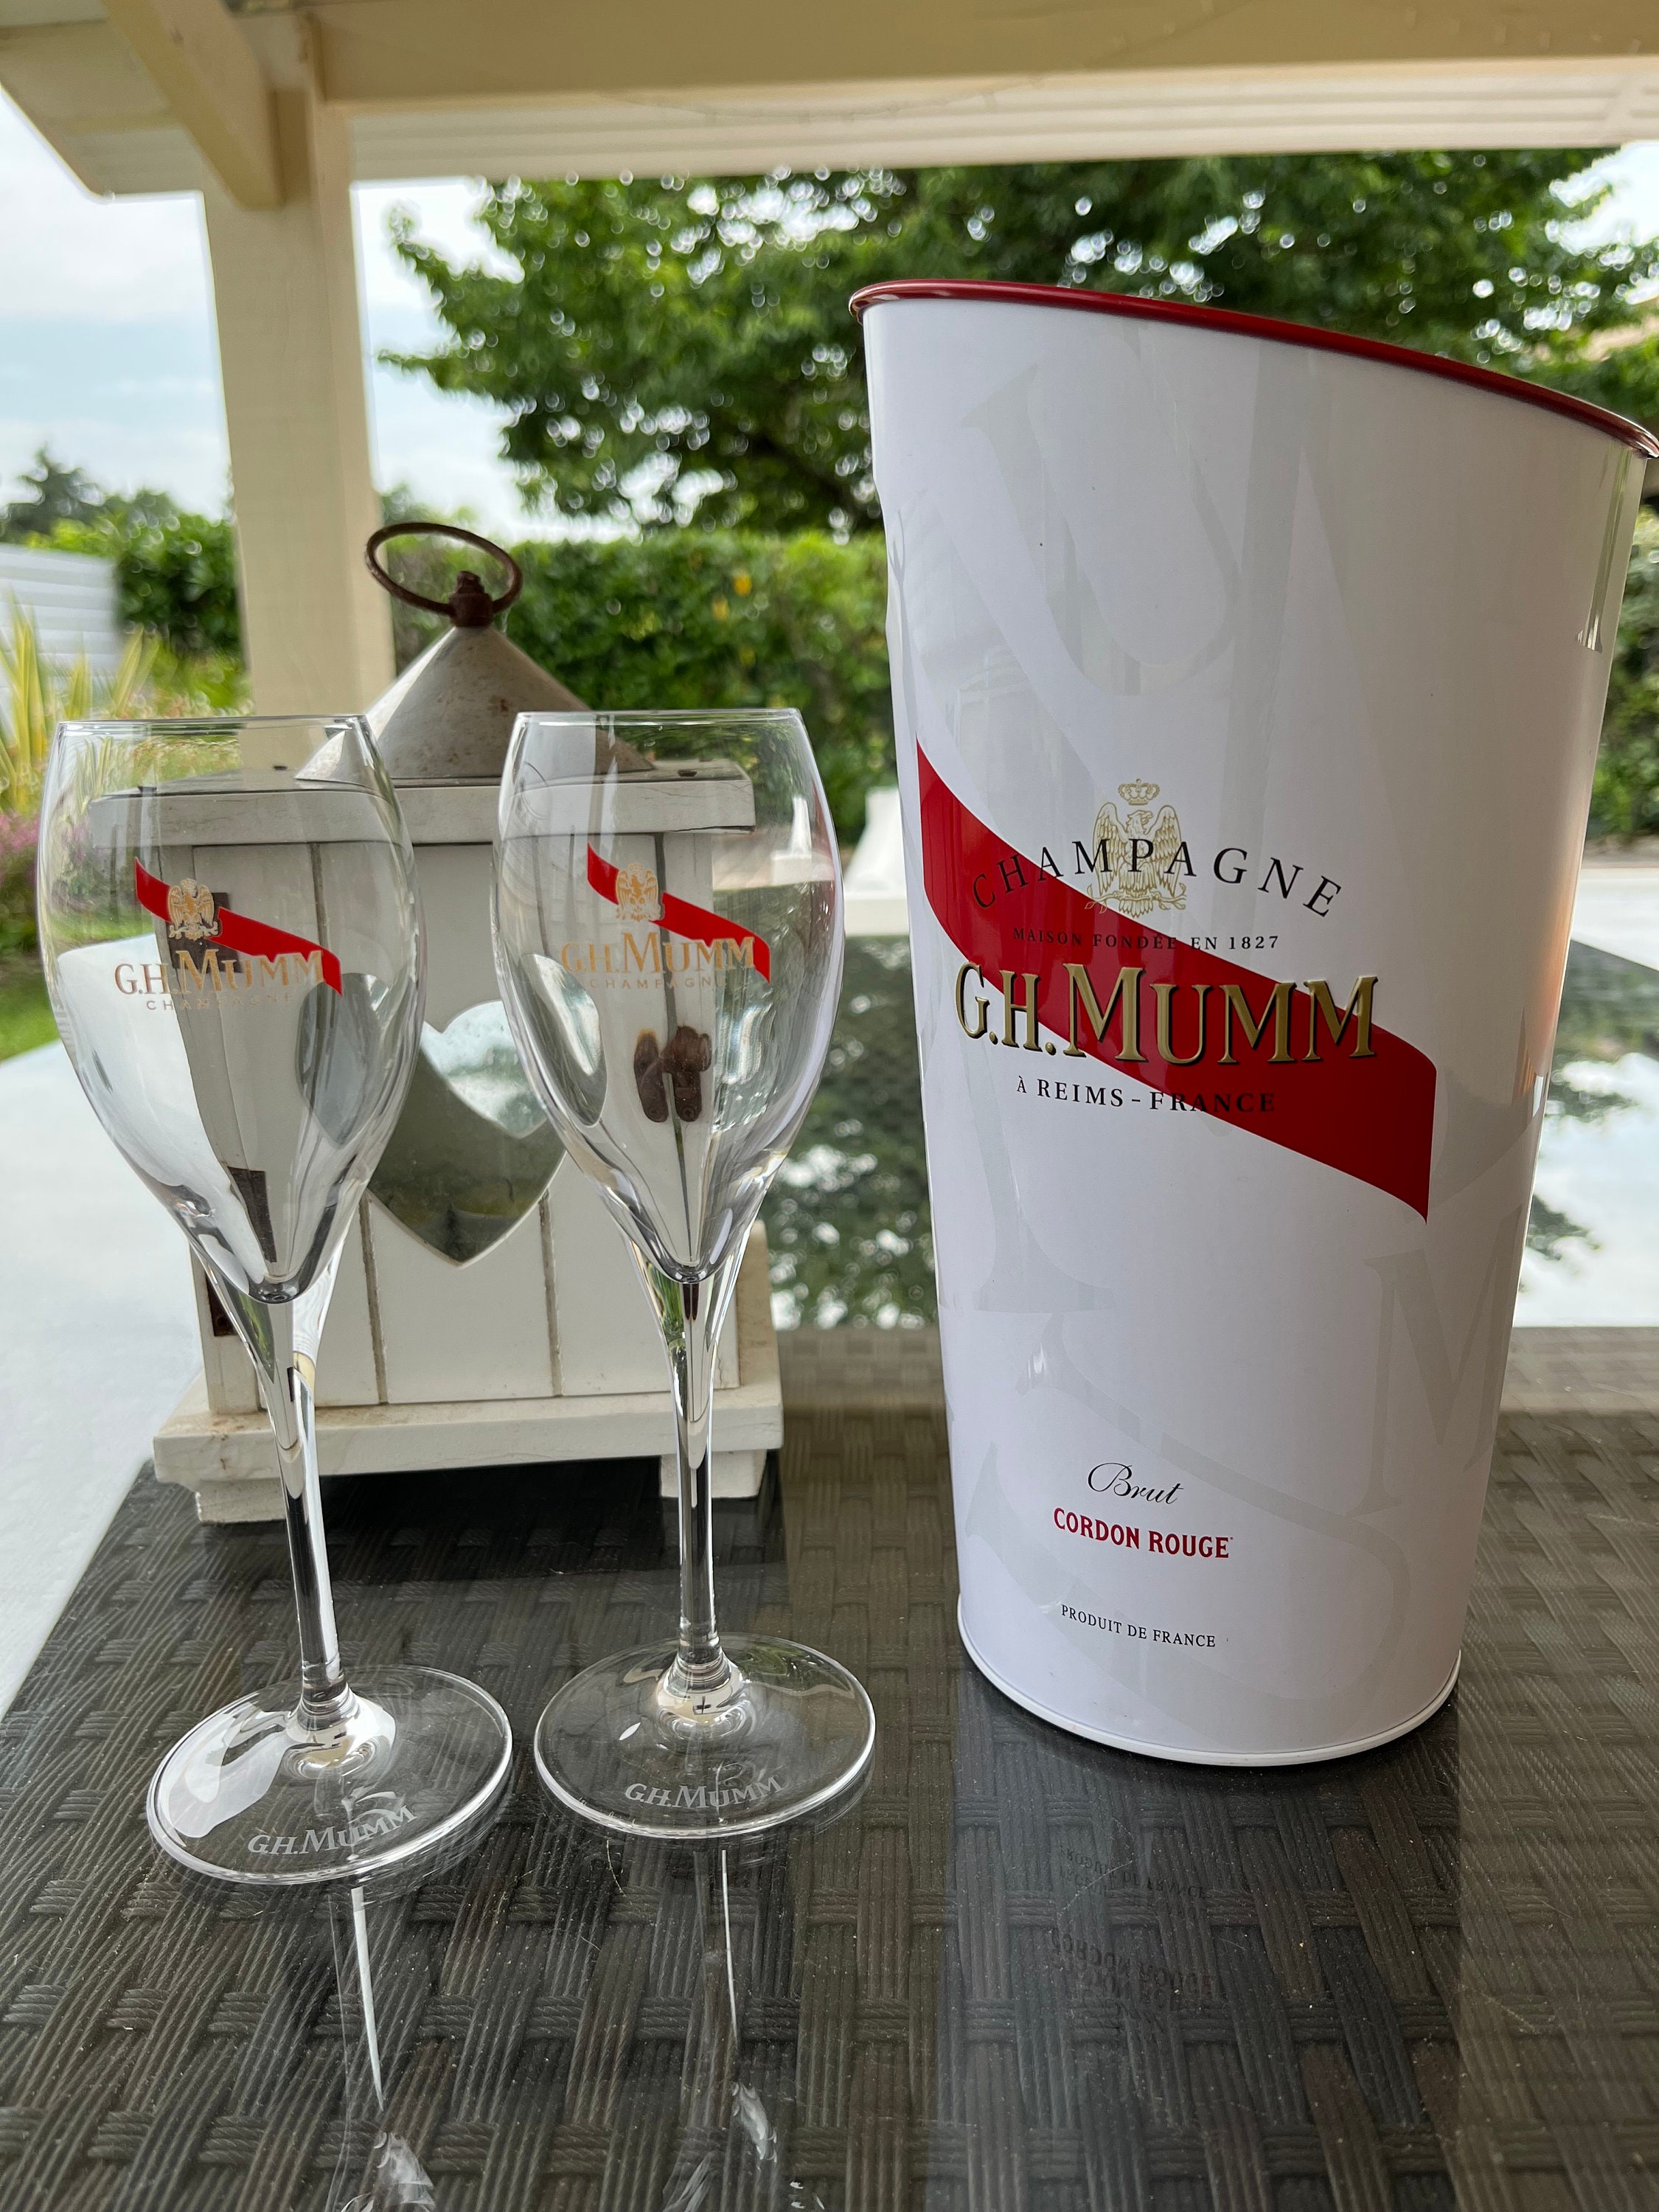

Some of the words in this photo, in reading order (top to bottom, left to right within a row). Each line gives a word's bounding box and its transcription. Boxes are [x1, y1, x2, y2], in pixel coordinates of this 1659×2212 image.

[972, 838, 1343, 918] CHAMPAGNE
[1013, 927, 1082, 946] MAISON
[1093, 933, 1178, 950] FONDÉE
[1191, 936, 1218, 950] EN
[1228, 935, 1279, 950] 1827
[1017, 1076, 1027, 1093] À
[1037, 1078, 1124, 1107] REIMS
[1150, 1091, 1276, 1113] FRANCE
[1088, 1462, 1184, 1504] Brut
[1054, 1508, 1140, 1549] CORDON
[1061, 1604, 1122, 1634] PRODUIT
[1127, 1624, 1147, 1640] DE
[1152, 1630, 1216, 1648] FRANCE
